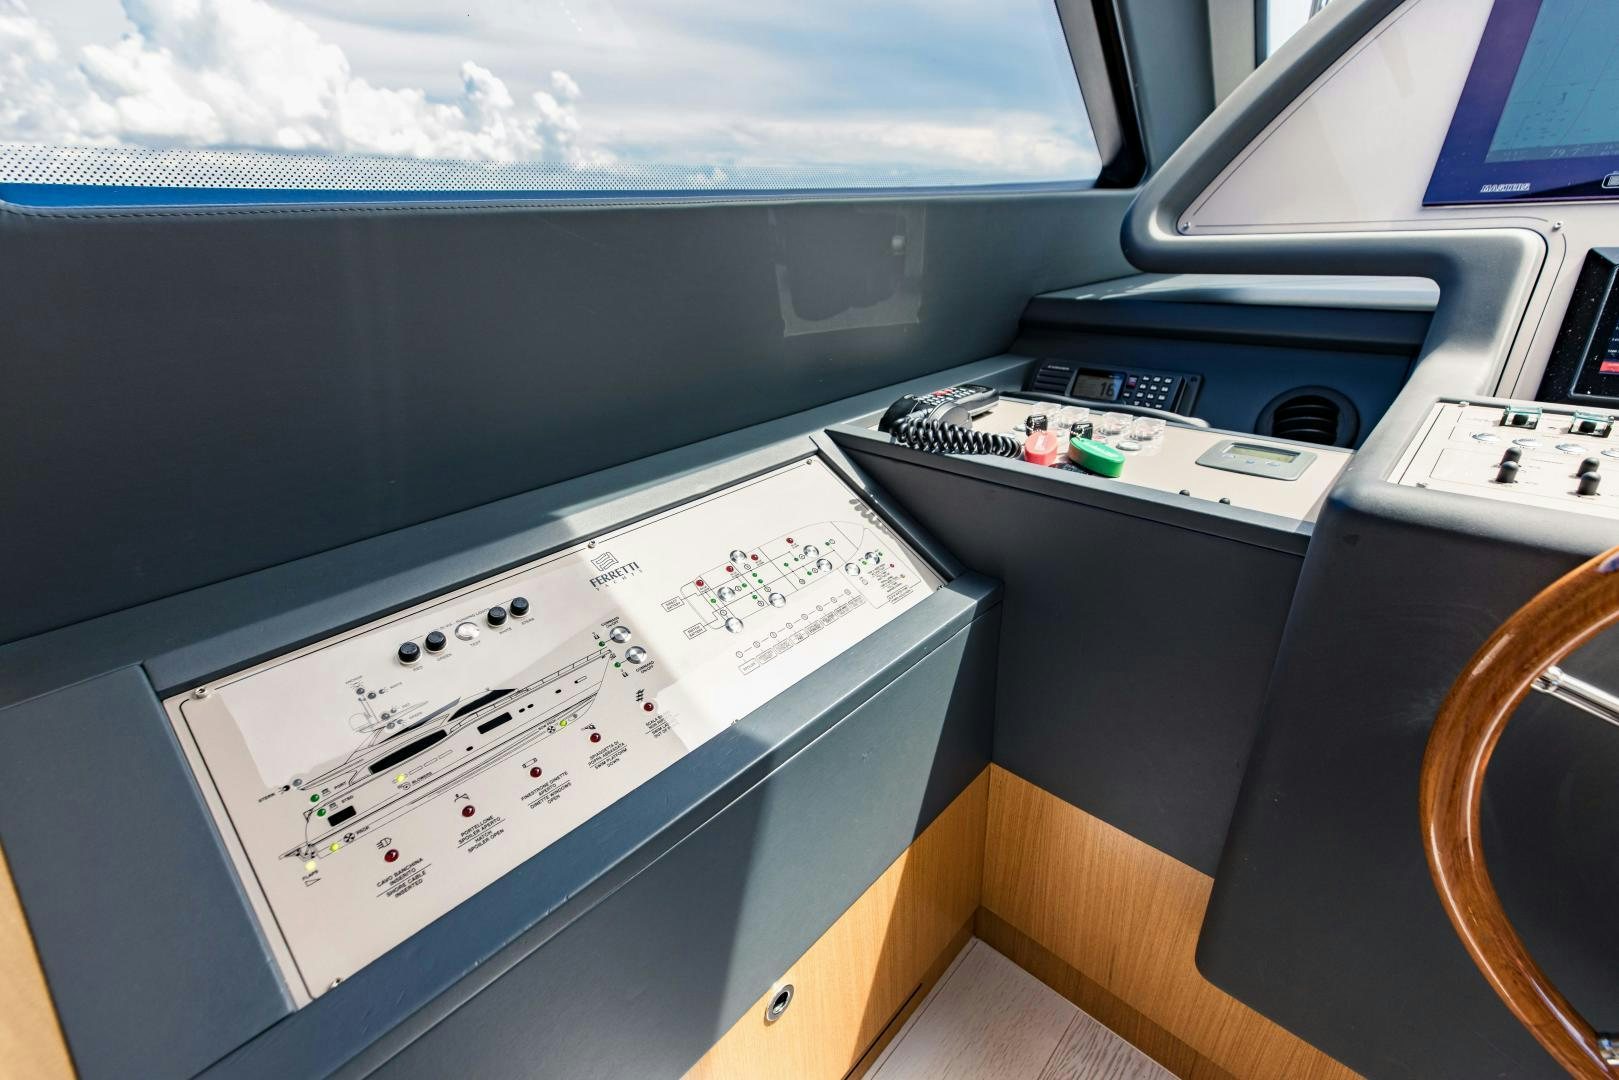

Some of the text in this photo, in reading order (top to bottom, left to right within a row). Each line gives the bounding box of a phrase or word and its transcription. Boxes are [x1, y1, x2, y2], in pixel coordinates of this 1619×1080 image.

[1099, 381, 1115, 396] 16
[589, 561, 640, 588] FERRETTI
[595, 747, 627, 769] SWIM PLATFORM
[607, 758, 620, 767] DOWN
[521, 771, 568, 801] FINESTRONE DINETTE
[530, 782, 571, 809] DINETTE WINDOWS
[538, 783, 556, 796] APERTO
[547, 794, 560, 804] OPEN
[459, 817, 501, 844] SPOILER APERTO
[460, 815, 494, 837] PORTELLONE
[475, 830, 492, 843] HATCH
[468, 828, 504, 853] SPOILER OPEN
[376, 857, 423, 887] CAVO BANCHINA
[390, 867, 416, 886] INSERITO
[386, 870, 426, 897] SHORE CABLE
[394, 878, 423, 898] INSERTED
